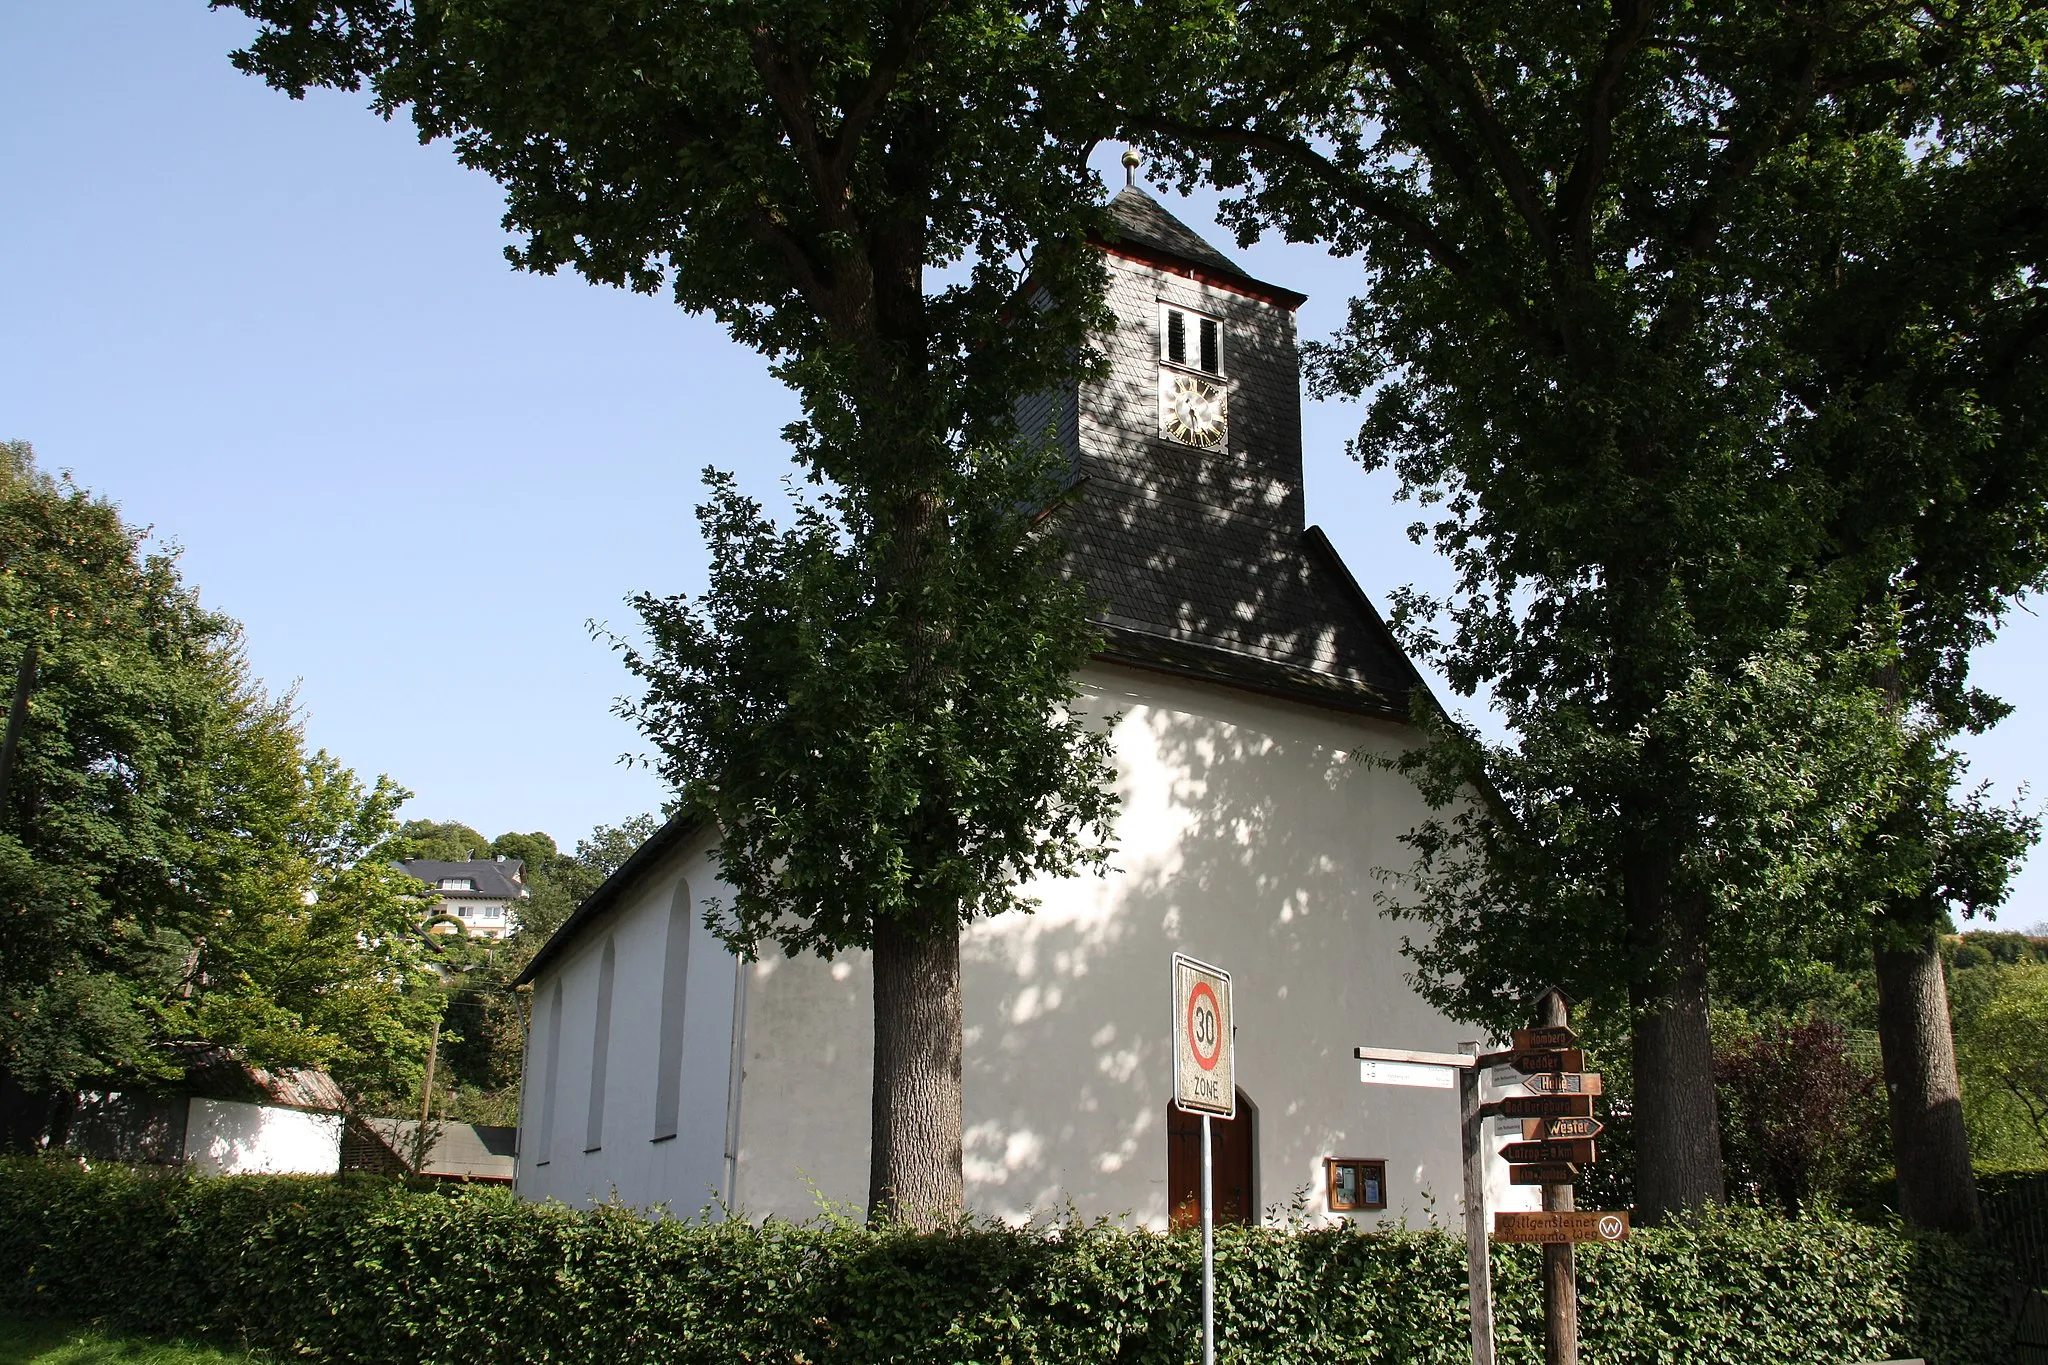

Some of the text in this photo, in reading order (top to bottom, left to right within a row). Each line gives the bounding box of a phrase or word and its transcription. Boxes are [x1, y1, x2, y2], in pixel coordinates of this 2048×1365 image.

[1195, 1006, 1214, 1046] 30
[1530, 1031, 1566, 1045] Homberg
[1522, 1055, 1558, 1069] Redder
[1194, 1076, 1219, 1100] ZONE
[1541, 1075, 1568, 1090] Helle
[1545, 1121, 1589, 1134] Wester
[1503, 1214, 1597, 1230] Wittgensteiner
[1504, 1227, 1598, 1242] Panorama Weg
